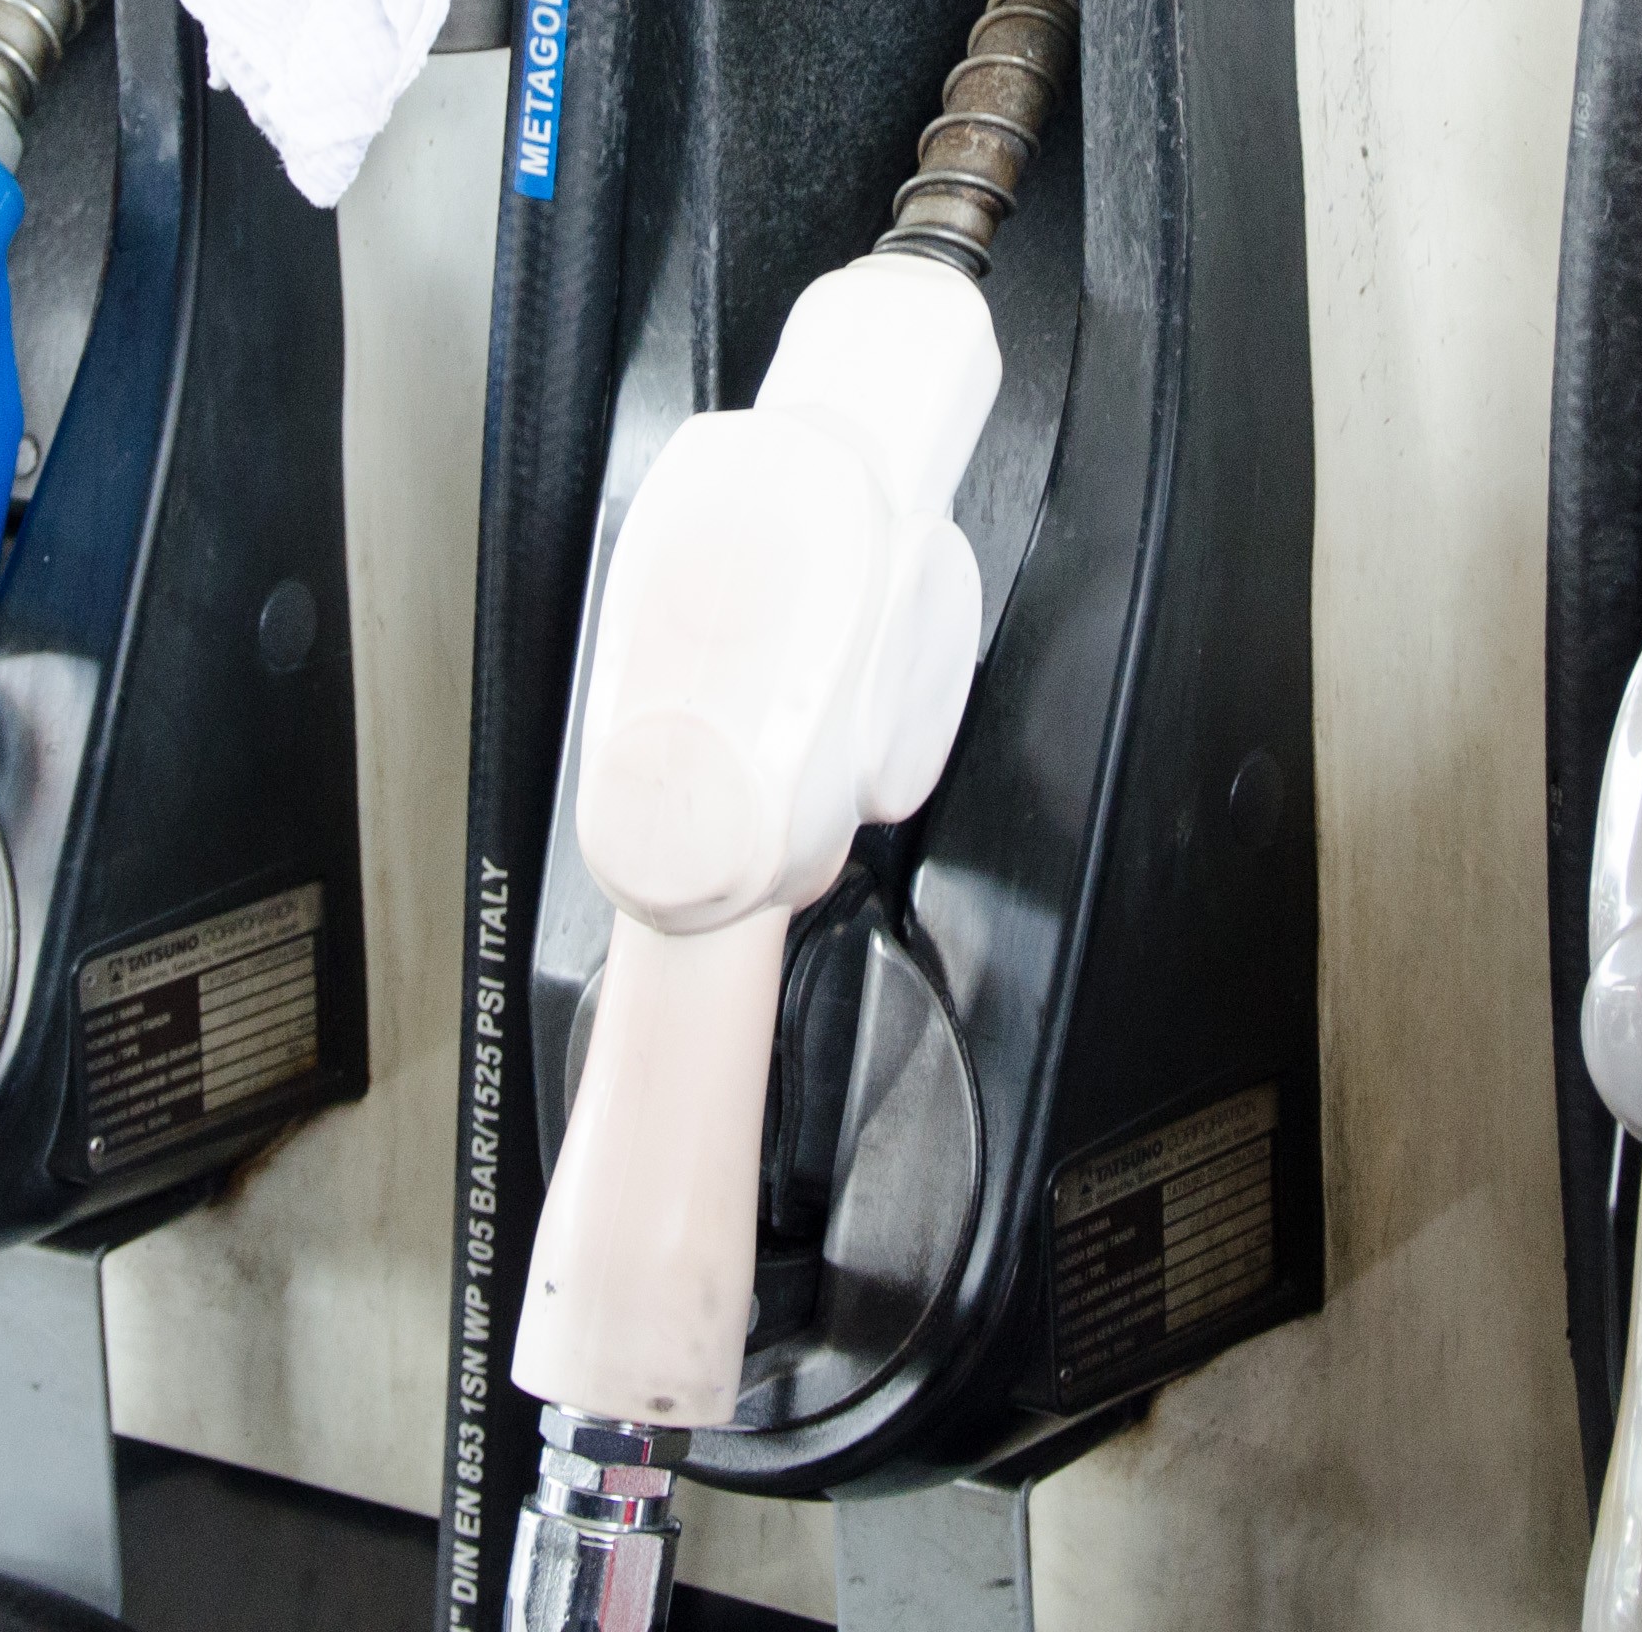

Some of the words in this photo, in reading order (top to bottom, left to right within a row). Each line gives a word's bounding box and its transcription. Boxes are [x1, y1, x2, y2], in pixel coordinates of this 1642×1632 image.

[479, 856, 510, 965] ITALY
[127, 934, 199, 974] TATSUNO
[474, 974, 506, 1040] PSI
[469, 1046, 504, 1214] BAR/1525
[1097, 1137, 1163, 1184] TATSUNO
[465, 1217, 495, 1277] 105
[462, 1284, 492, 1345] WP
[459, 1349, 489, 1416] 1SN
[456, 1421, 485, 1484] 853
[454, 1485, 482, 1539] EN
[451, 1539, 480, 1605] DIN
